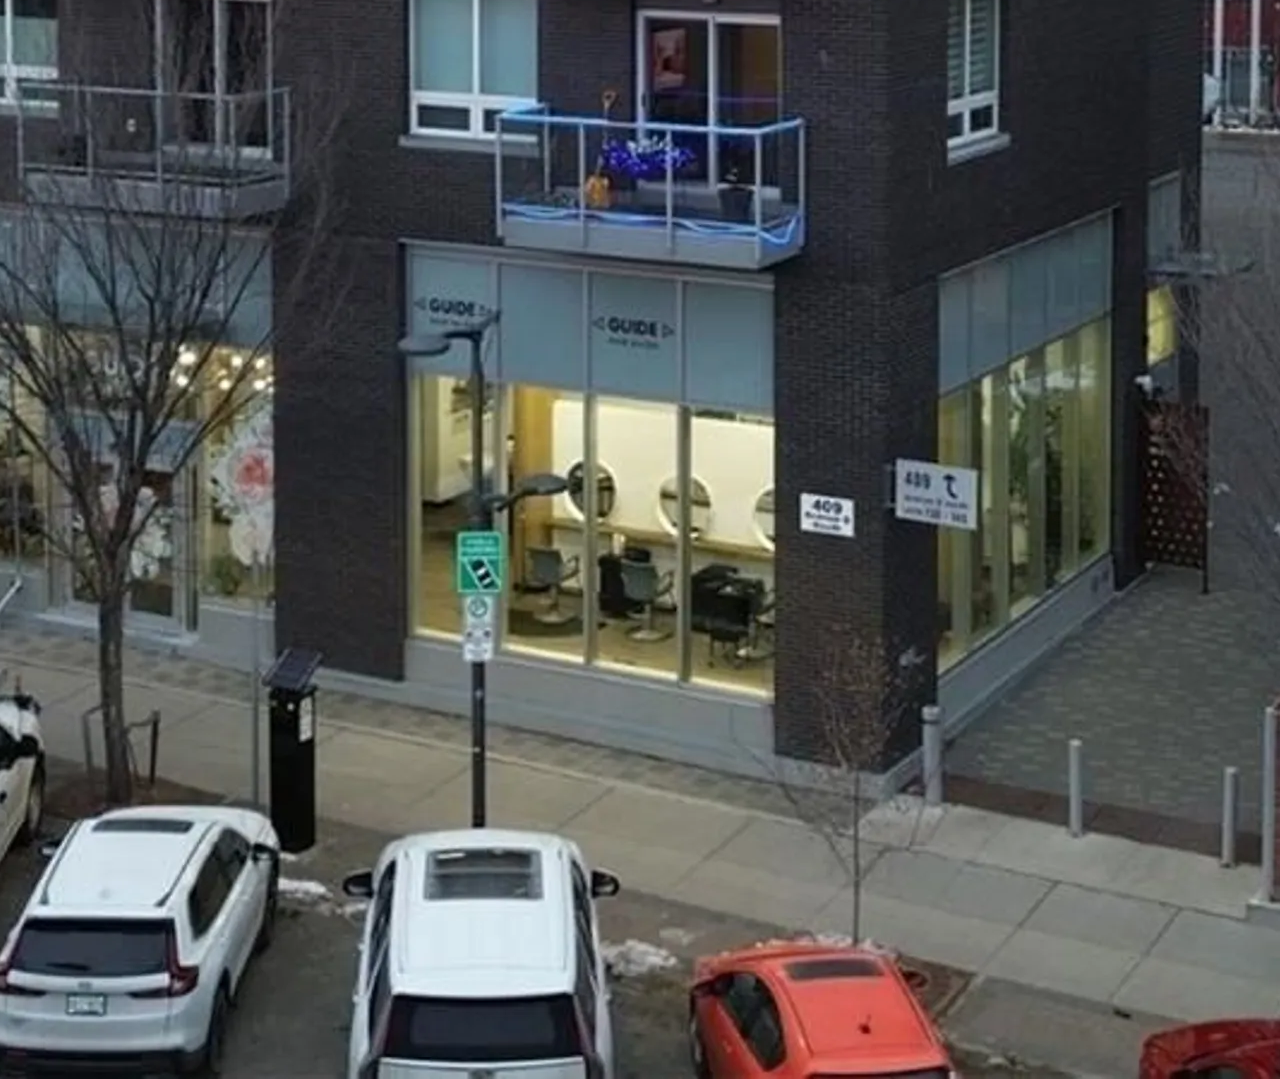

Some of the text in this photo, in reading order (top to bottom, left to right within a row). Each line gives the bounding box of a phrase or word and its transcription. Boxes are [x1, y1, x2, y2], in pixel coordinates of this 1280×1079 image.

[428, 298, 475, 318] GUIDE
[608, 317, 659, 337] GUIDE
[812, 499, 843, 515] 409
